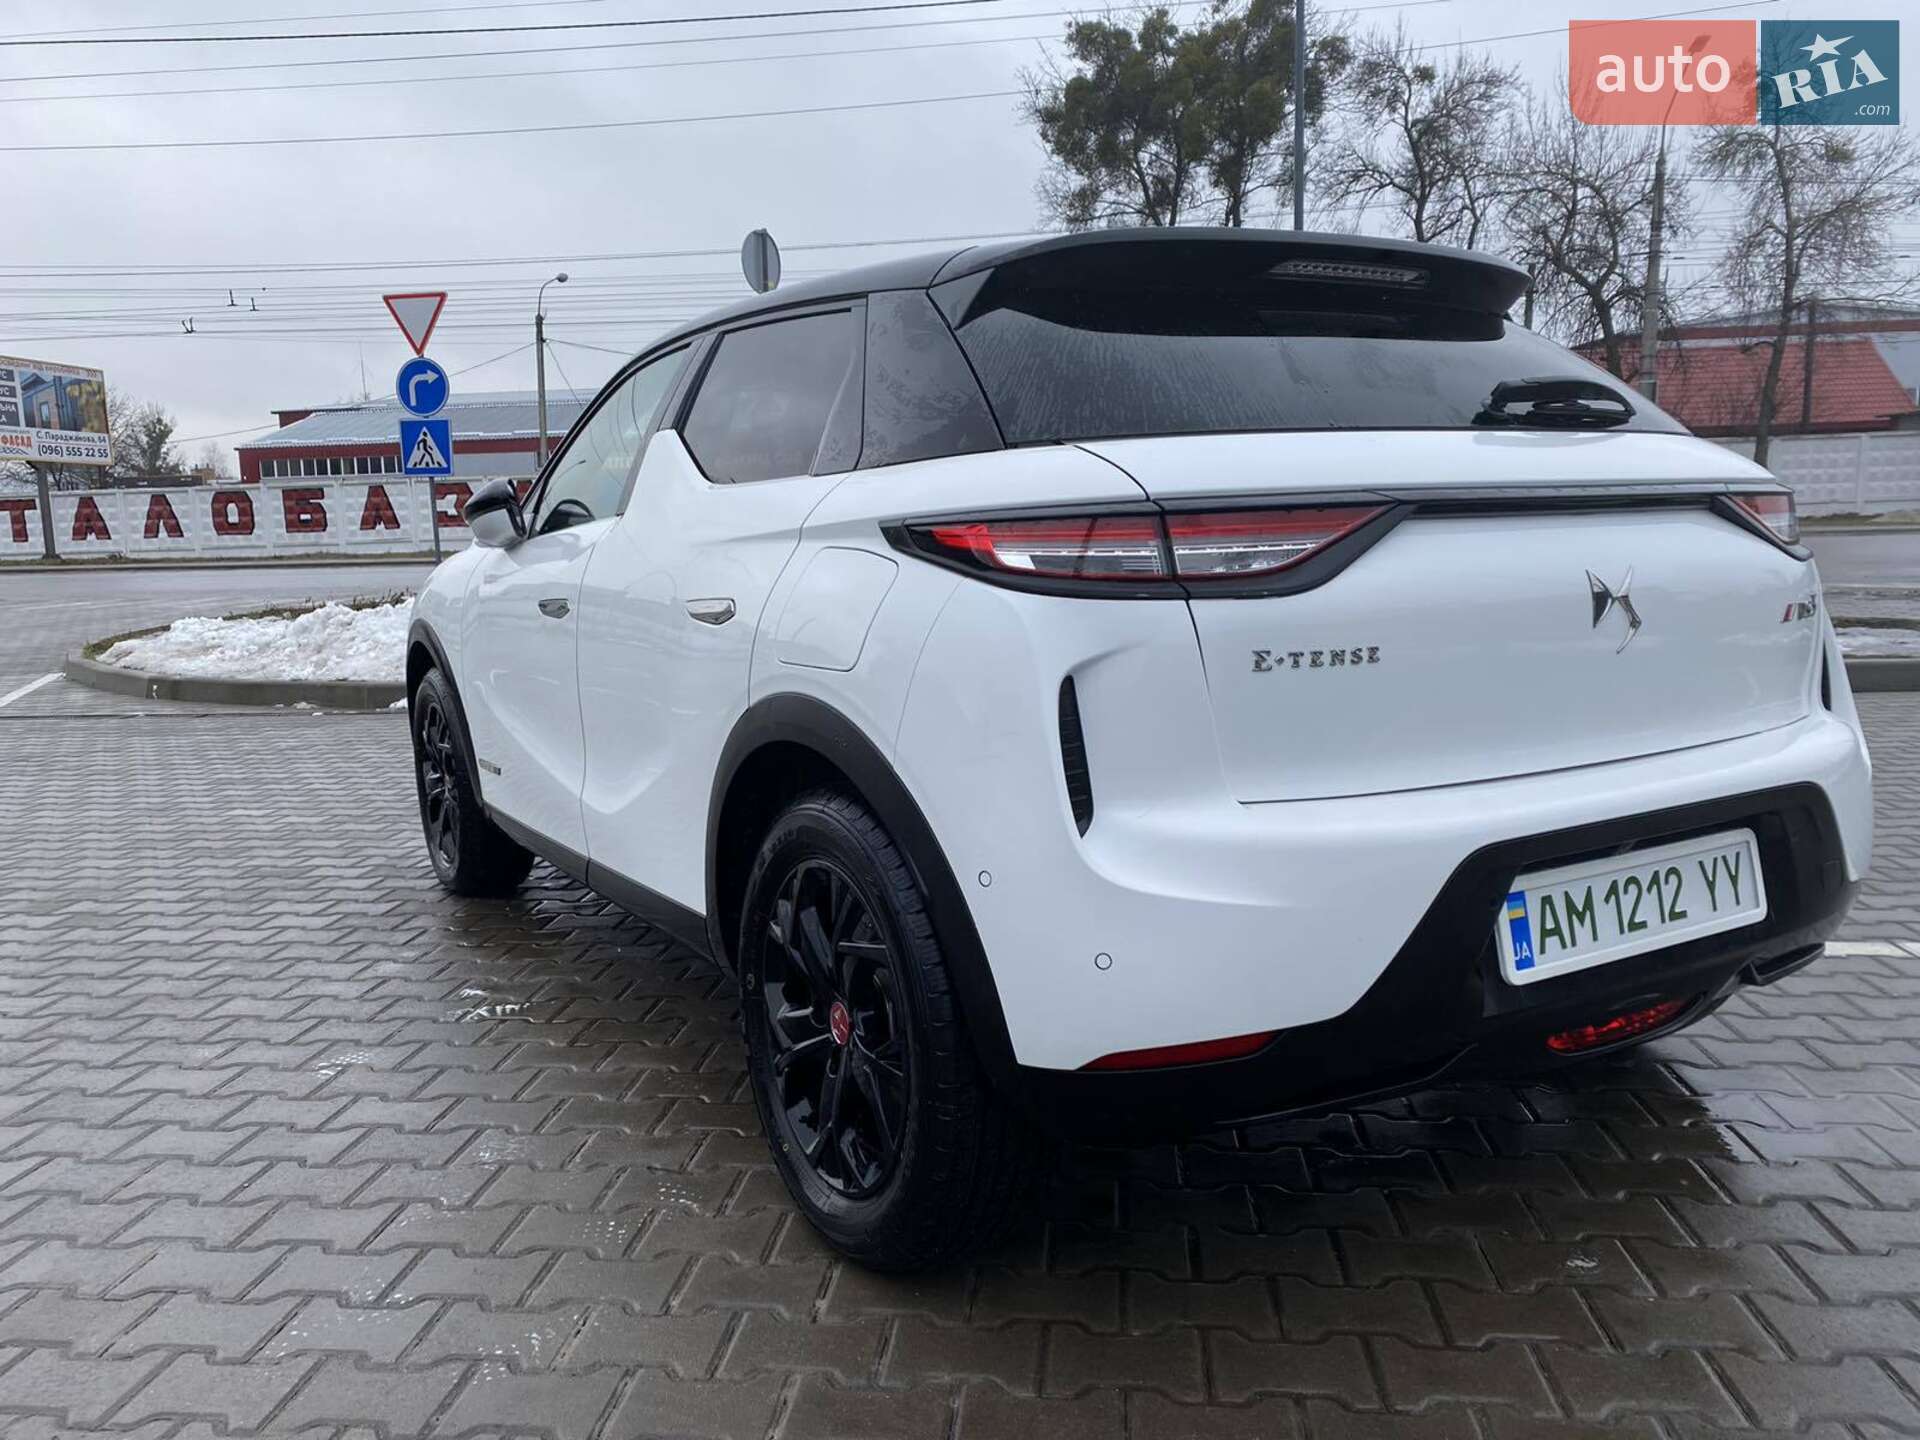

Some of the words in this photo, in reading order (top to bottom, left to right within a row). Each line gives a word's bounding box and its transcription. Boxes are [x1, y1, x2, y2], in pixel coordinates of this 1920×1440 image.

[1, 434, 33, 448] ФАСАД
[38, 444, 63, 457] (096)
[66, 446, 83, 457] 555
[85, 447, 96, 458] 22
[98, 448, 109, 458] 55
[1539, 885, 1598, 955] AM
[1604, 866, 1688, 935] 1212
[1697, 851, 1741, 912] YY
